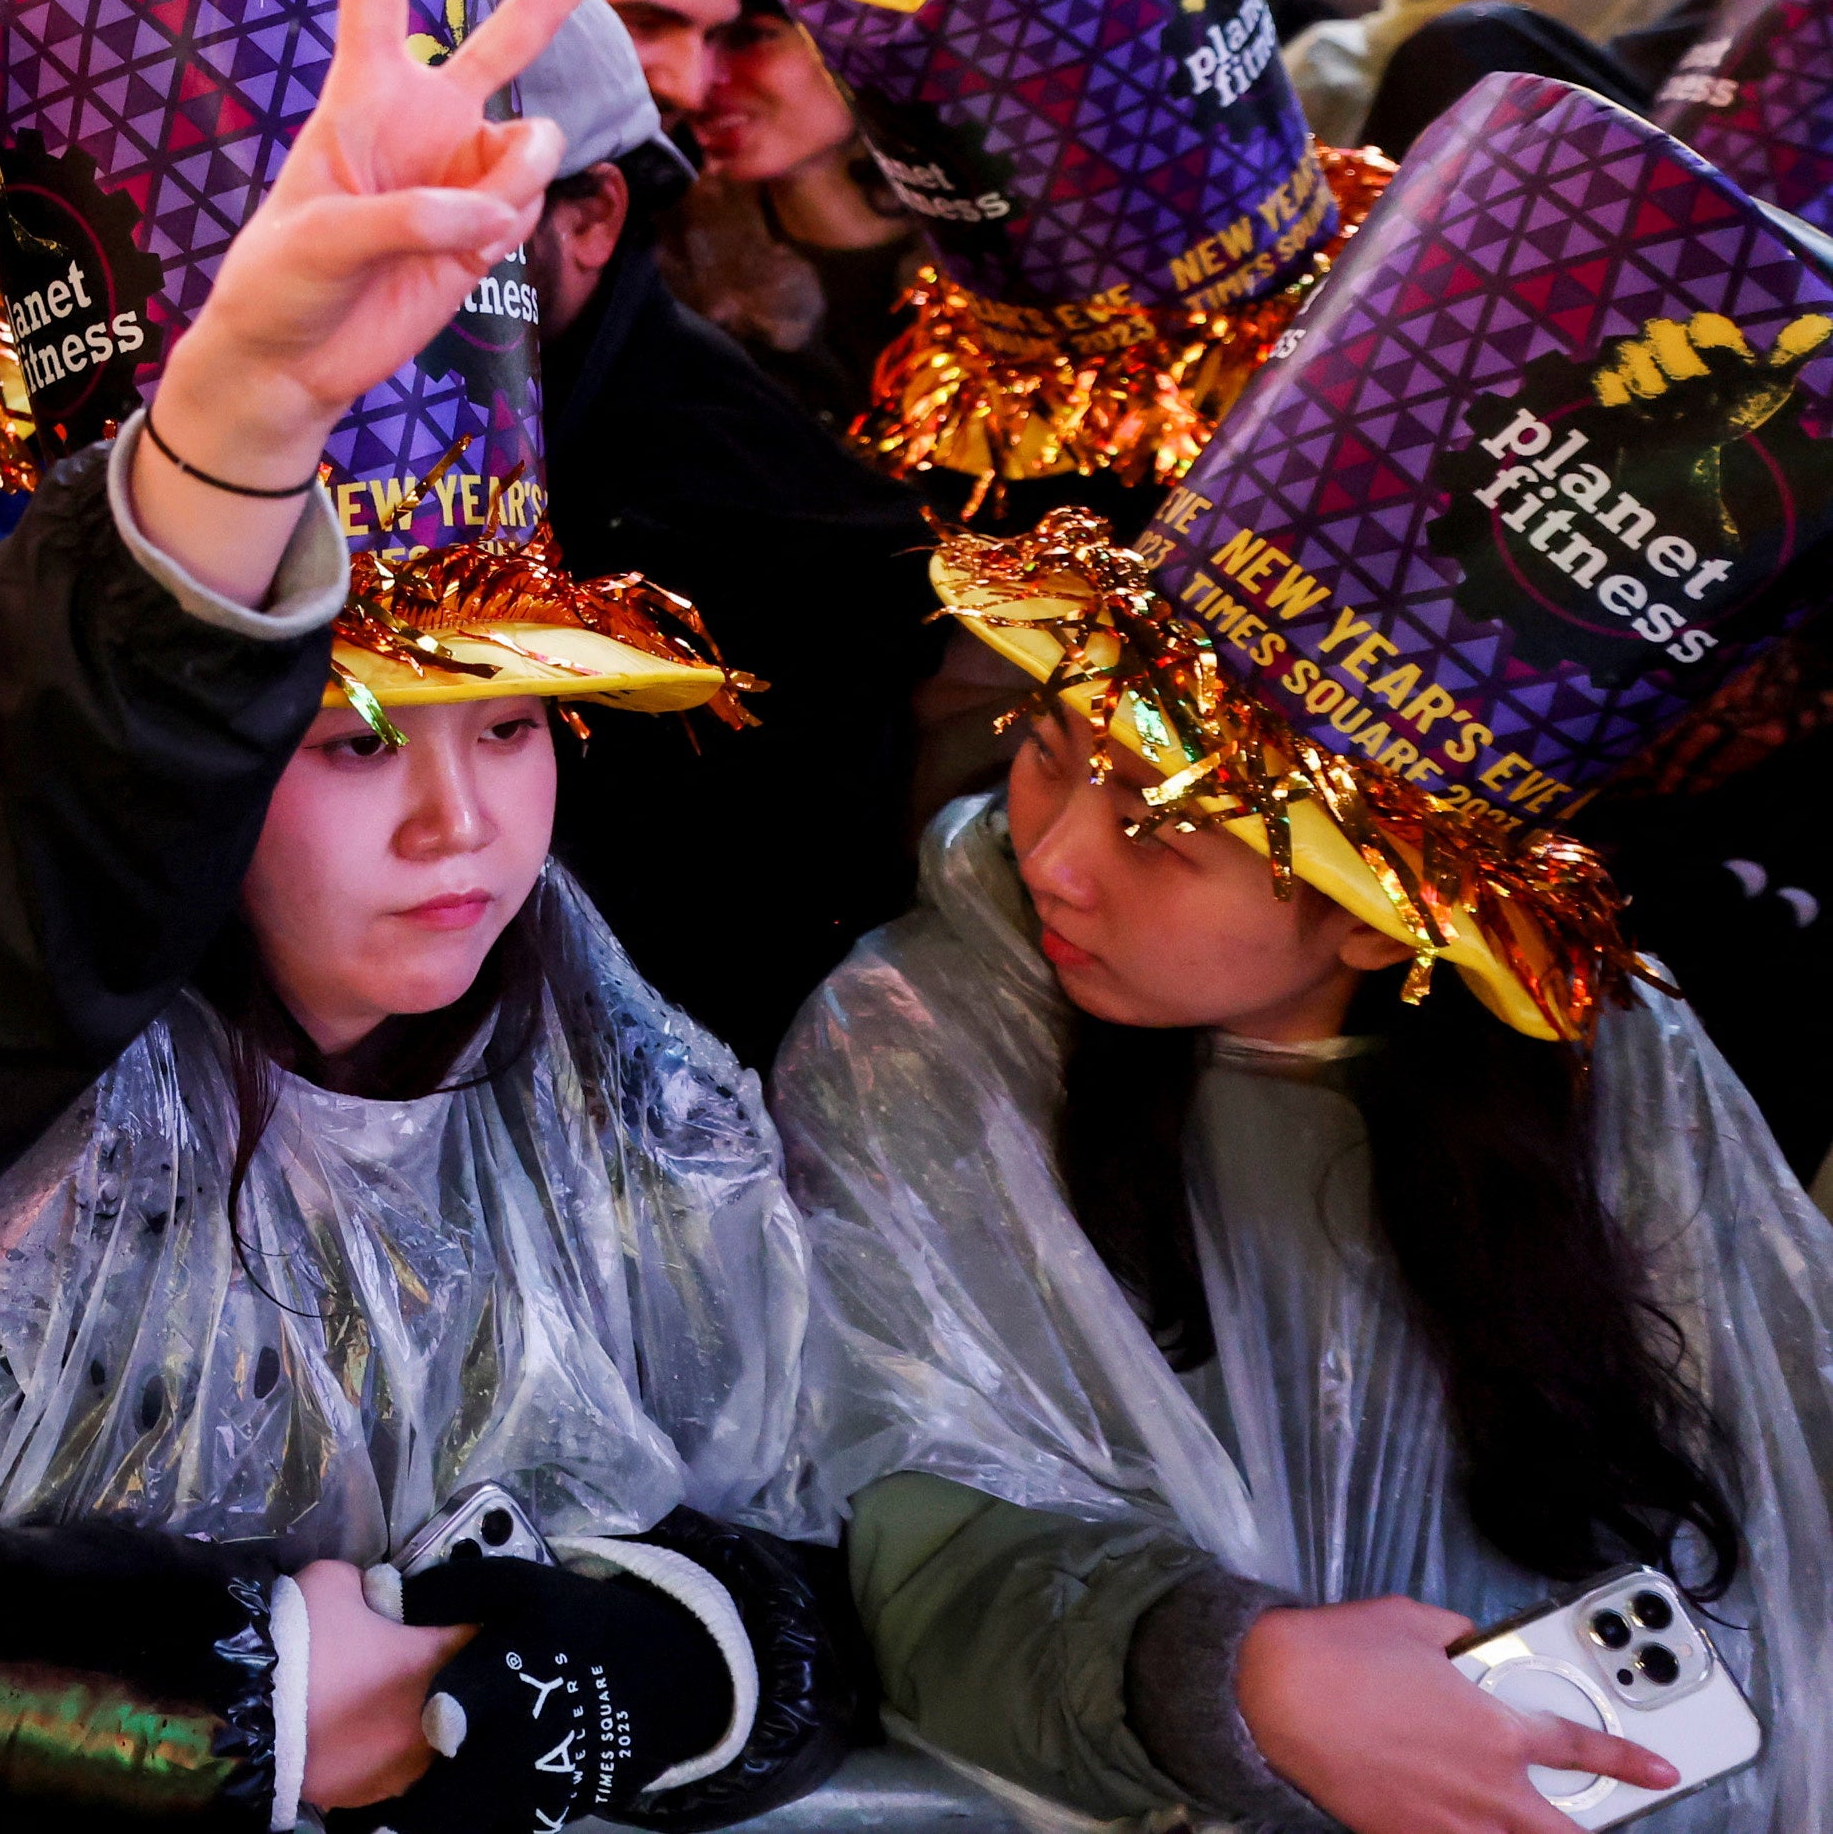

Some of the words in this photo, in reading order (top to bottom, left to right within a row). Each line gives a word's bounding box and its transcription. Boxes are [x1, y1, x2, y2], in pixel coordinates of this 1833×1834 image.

[1169, 214, 1254, 292] NEW
[5, 259, 93, 343] lanet
[455, 273, 540, 327] tness
[17, 310, 145, 398] itness
[327, 478, 415, 537] EW
[434, 473, 546, 531] YEAR'S
[1155, 485, 1214, 536] EVE
[1479, 407, 1734, 601] planet
[1472, 464, 1719, 664] fitness
[1179, 570, 1288, 668] TIMES
[1280, 658, 1444, 787] SQUARE
[1209, 528, 1332, 622] NEW
[1317, 605, 1495, 765] YEAR'S
[1477, 751, 1574, 815] EVE
[590, 1664, 615, 1742] SQUARE
[615, 1709, 633, 1759] 2023
[594, 1750, 615, 1804] TIMES
